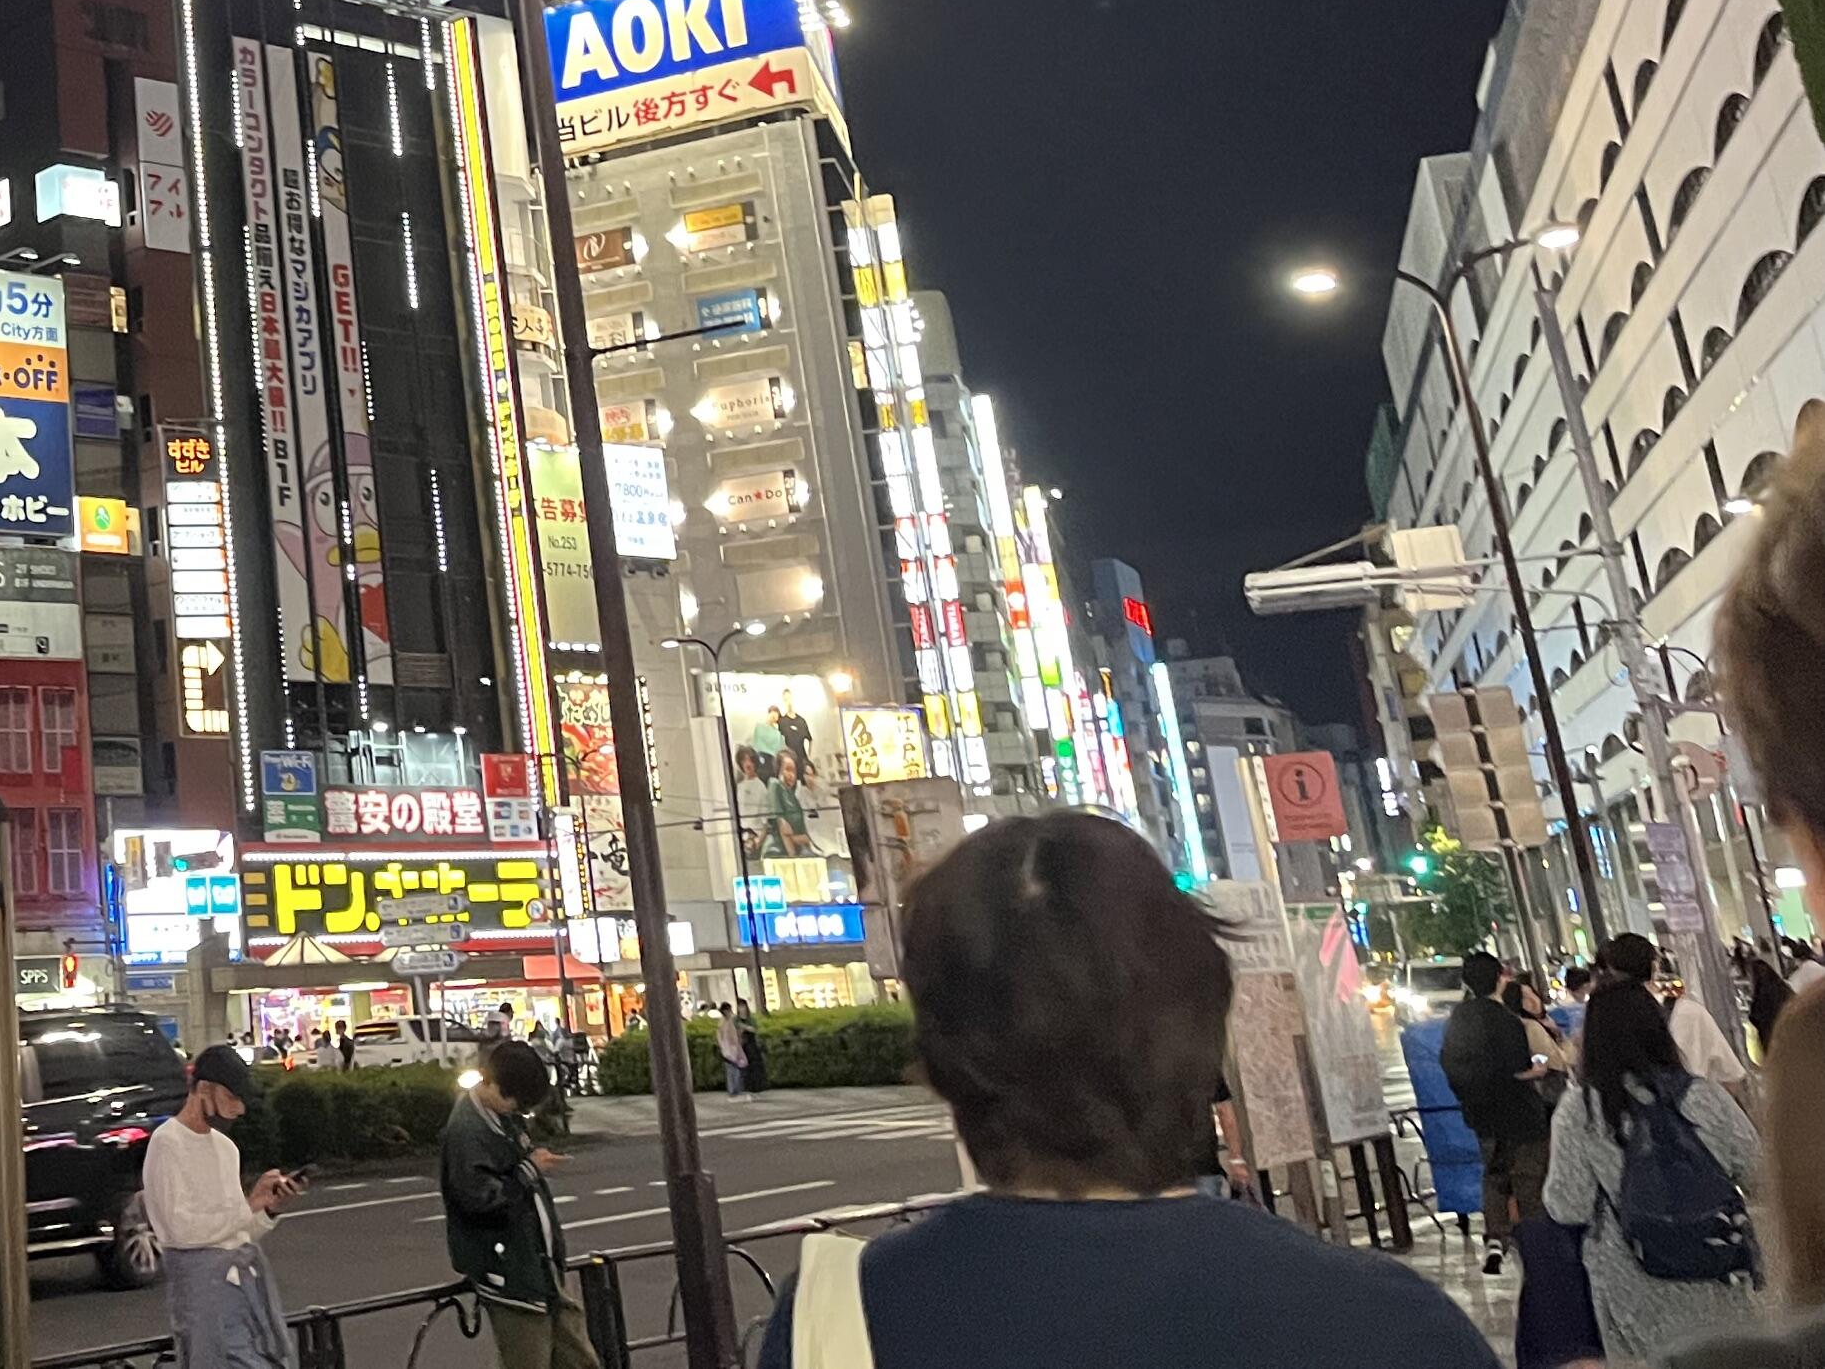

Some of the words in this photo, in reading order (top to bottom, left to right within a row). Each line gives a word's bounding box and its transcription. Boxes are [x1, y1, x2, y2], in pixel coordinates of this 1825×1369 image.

[0, 321, 59, 343] City方面
[324, 790, 485, 835] 驚安の殿堂
